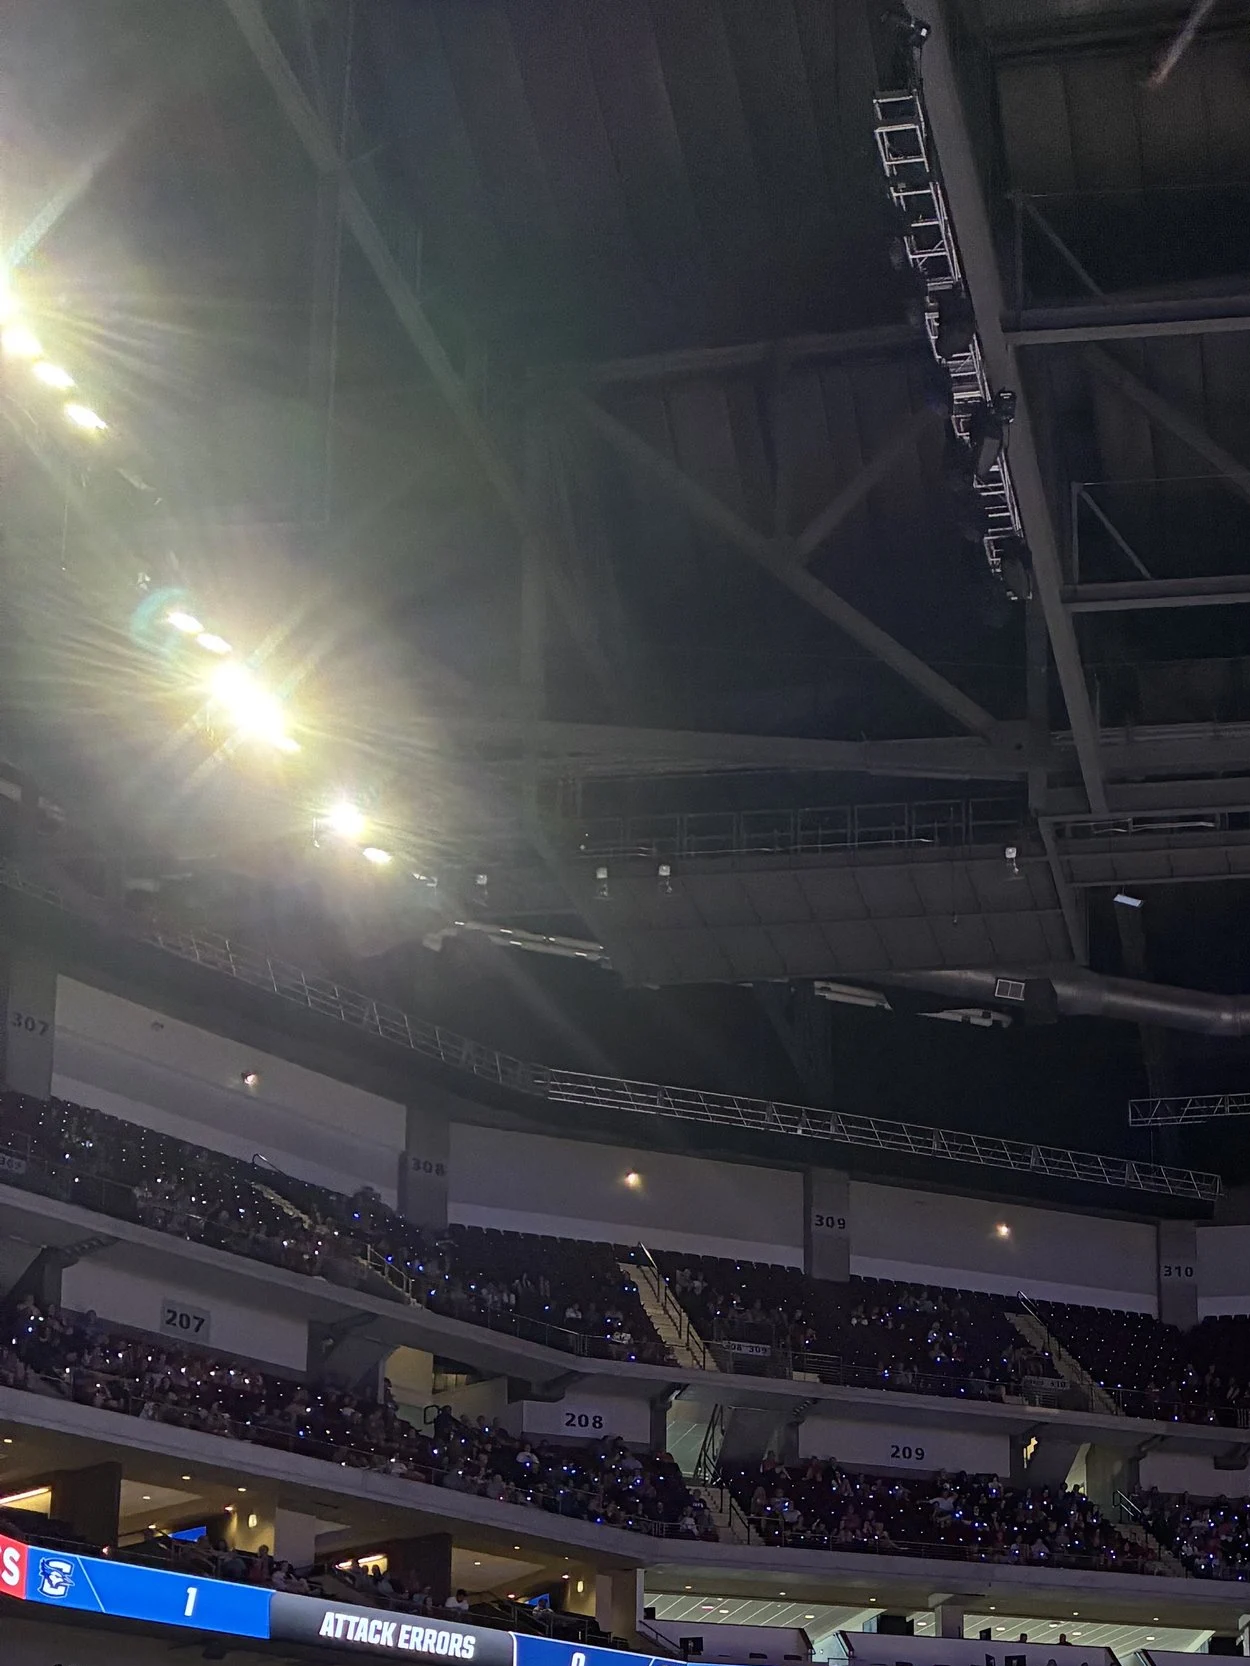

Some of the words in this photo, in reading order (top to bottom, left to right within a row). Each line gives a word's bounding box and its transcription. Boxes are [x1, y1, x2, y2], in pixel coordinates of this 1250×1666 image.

[12, 1012, 49, 1036] 307
[815, 1215, 846, 1229] 309
[1164, 1265, 1193, 1278] 310
[166, 1309, 205, 1333] 207
[565, 1413, 604, 1430] 208
[891, 1445, 925, 1461] 209
[184, 1587, 197, 1617] 1
[319, 1612, 398, 1647] ATTACK
[398, 1623, 476, 1660] ERRORS
